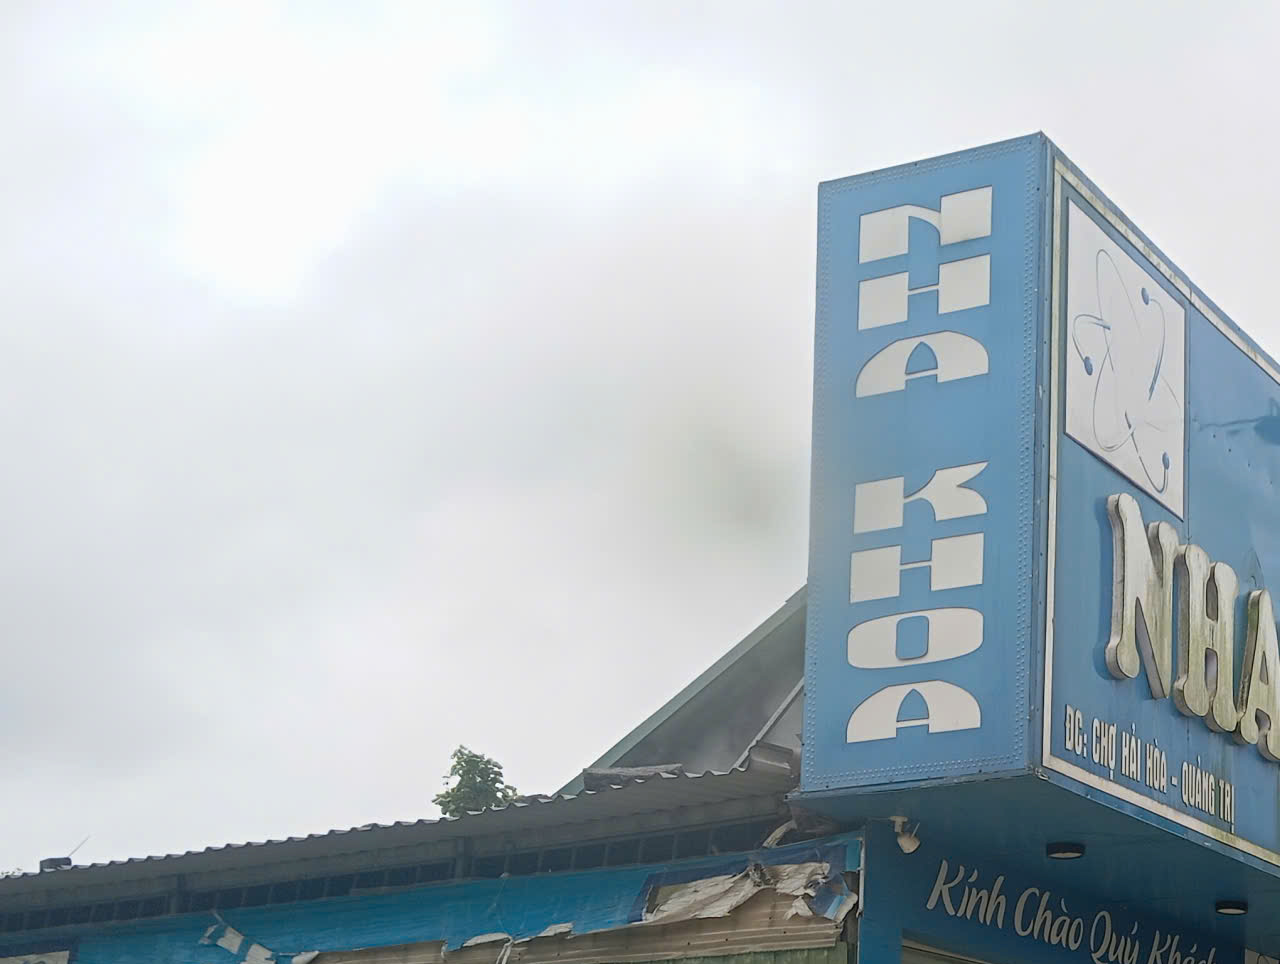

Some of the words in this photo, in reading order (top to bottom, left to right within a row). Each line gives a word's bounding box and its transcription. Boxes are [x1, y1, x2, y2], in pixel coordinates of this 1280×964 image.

[855, 185, 993, 399] NHA
[846, 461, 990, 744] KHOA
[1065, 704, 1088, 758] ĐC:
[1092, 717, 1117, 780] CHỢ
[1121, 722, 1141, 782] HẢI
[1145, 738, 1168, 794] HÒA
[1181, 755, 1216, 816] QUẢNG
[1218, 778, 1236, 834] TRỊ
[926, 859, 1005, 929] Kính
[1014, 887, 1085, 951] Chào
